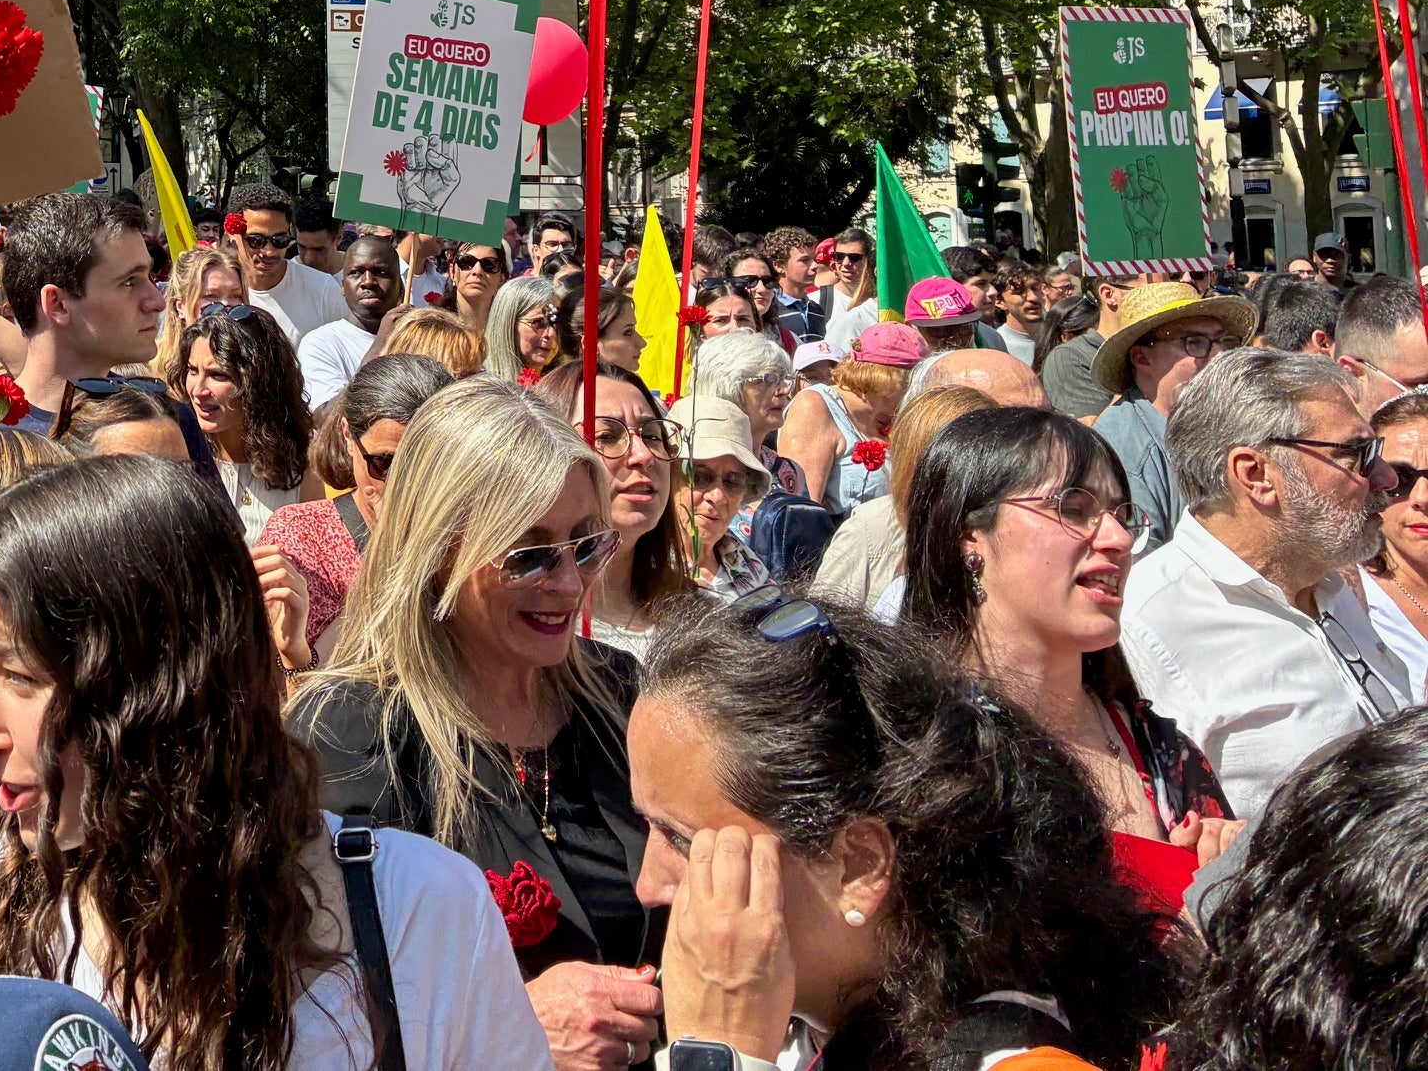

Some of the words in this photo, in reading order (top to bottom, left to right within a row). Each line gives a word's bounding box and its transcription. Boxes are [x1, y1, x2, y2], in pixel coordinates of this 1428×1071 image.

[450, 2, 475, 30] JS
[407, 37, 428, 56] EU
[431, 39, 488, 64] QUERO
[1128, 37, 1145, 64] JS
[386, 52, 498, 109] SEMANA
[1097, 92, 1115, 110] EU
[1118, 87, 1166, 108] QUERO
[372, 91, 409, 132] DE
[414, 100, 434, 136] 4
[440, 104, 501, 150] DIAS
[1081, 111, 1167, 146] PROPINA
[43, 1021, 126, 1071] AWKINS
